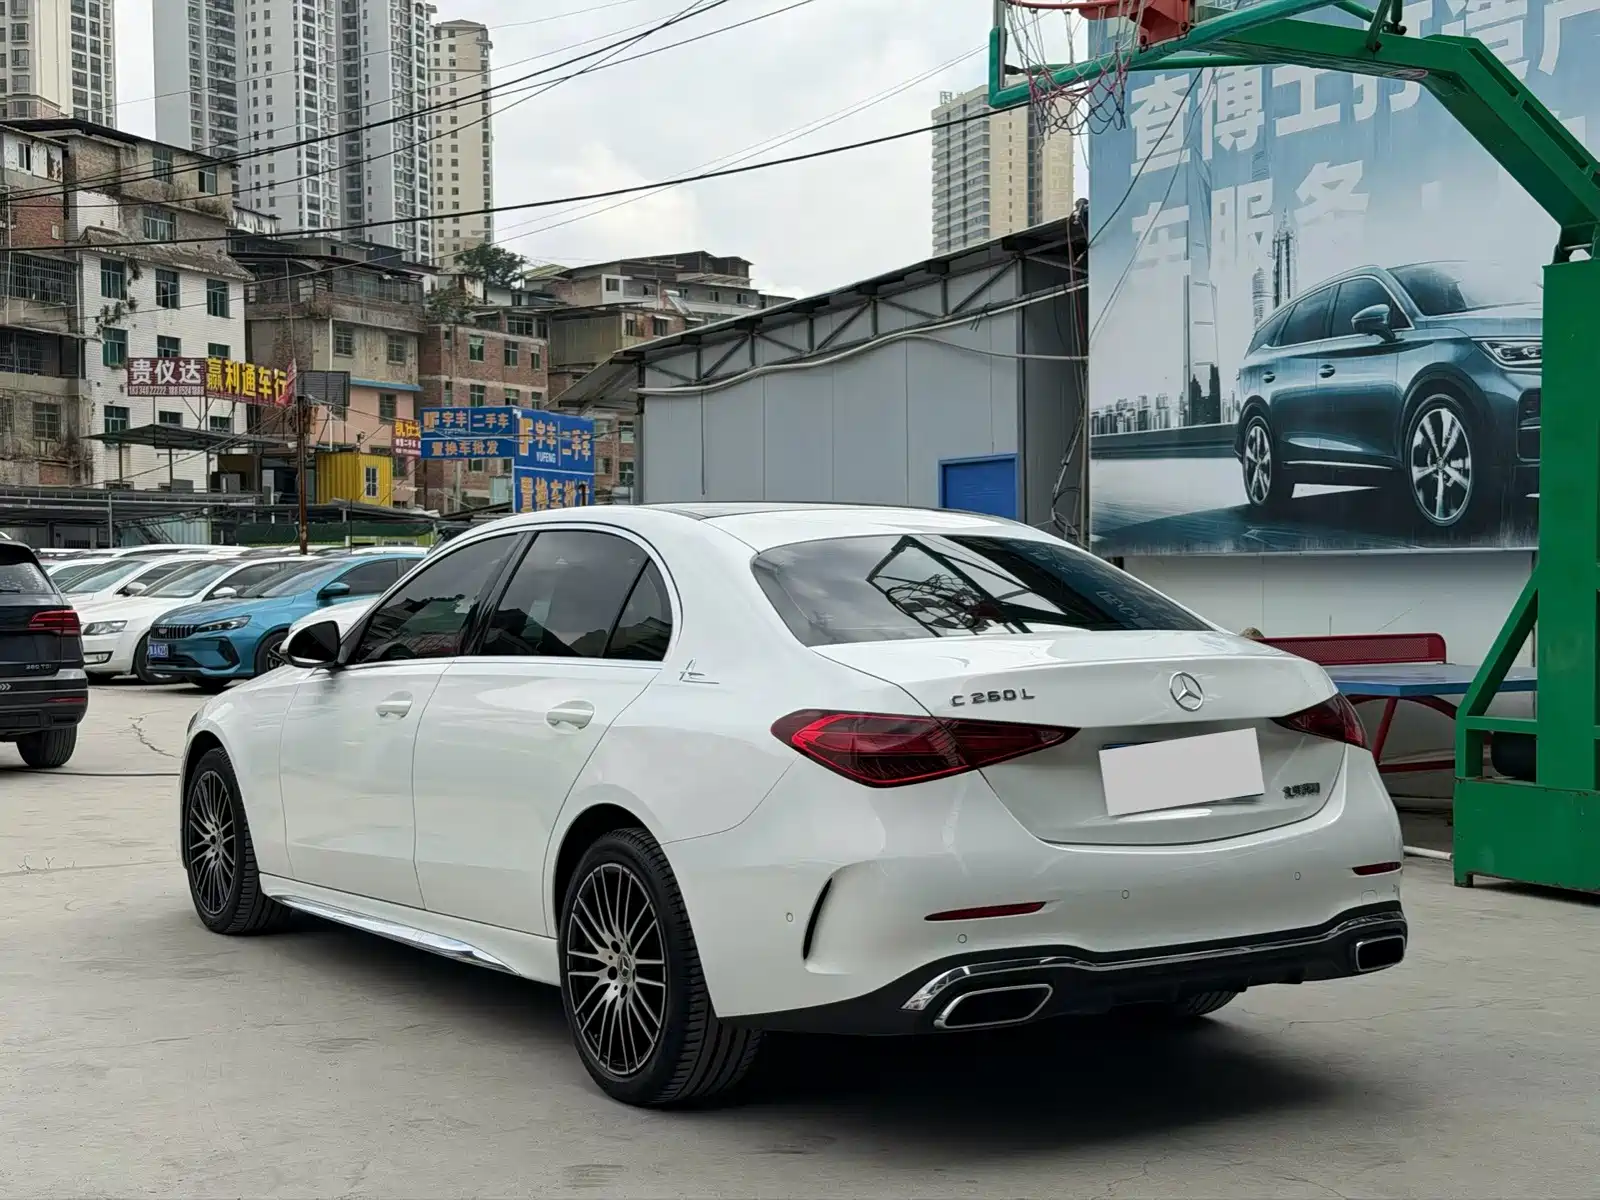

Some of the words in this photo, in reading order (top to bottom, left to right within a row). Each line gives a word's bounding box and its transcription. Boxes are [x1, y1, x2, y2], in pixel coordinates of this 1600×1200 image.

[131, 358, 201, 384] 贵仪达
[206, 357, 288, 399] 赢利通车行
[442, 410, 468, 428] 宇丰
[472, 412, 510, 429] 二手车
[431, 439, 499, 456] 置换车批发
[561, 429, 592, 462] 二手车
[536, 451, 556, 463] YUFENG
[951, 695, 966, 707] C
[970, 689, 1017, 704] 260
[1021, 688, 1036, 700] L
